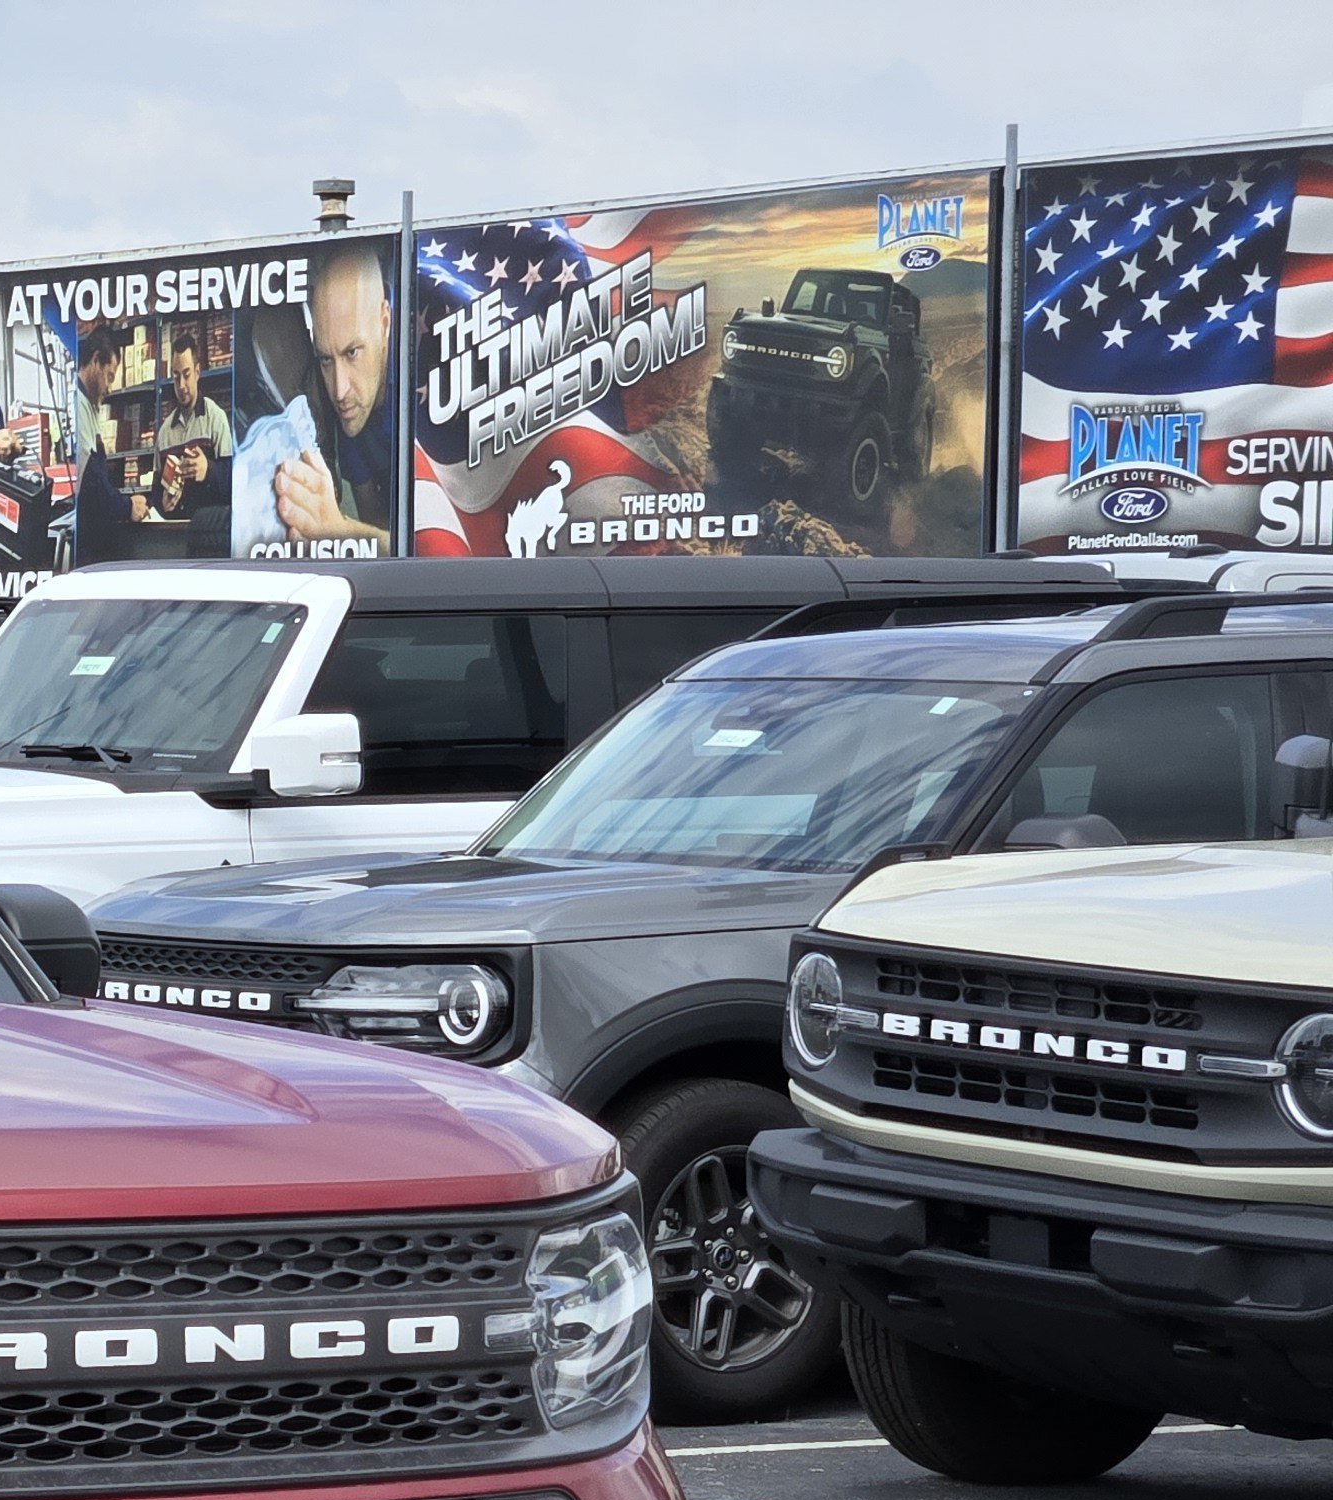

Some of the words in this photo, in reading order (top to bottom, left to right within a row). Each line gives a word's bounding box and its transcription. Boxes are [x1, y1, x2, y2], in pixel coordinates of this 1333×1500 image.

[877, 193, 965, 249] PLANET
[906, 249, 935, 268] Ford
[7, 284, 48, 328] AT
[53, 273, 148, 323] YOUR
[155, 258, 309, 314] SERVICE
[428, 251, 652, 425] ULTIMATE
[433, 288, 503, 363] THE
[468, 286, 706, 468] FREEDOM!
[1070, 404, 1205, 484] PLANET
[621, 494, 656, 516] THE
[658, 492, 706, 514] FORD
[1071, 473, 1119, 499] DALLAS
[1123, 471, 1155, 482] LOVE
[1159, 473, 1196, 494] FIELD
[1112, 492, 1156, 518] Ford
[570, 514, 759, 544] BRONCO
[1068, 532, 1199, 550] PlanetFordDallas.com
[96, 981, 271, 1011] RONCO
[882, 1012, 1187, 1071] BRONCO
